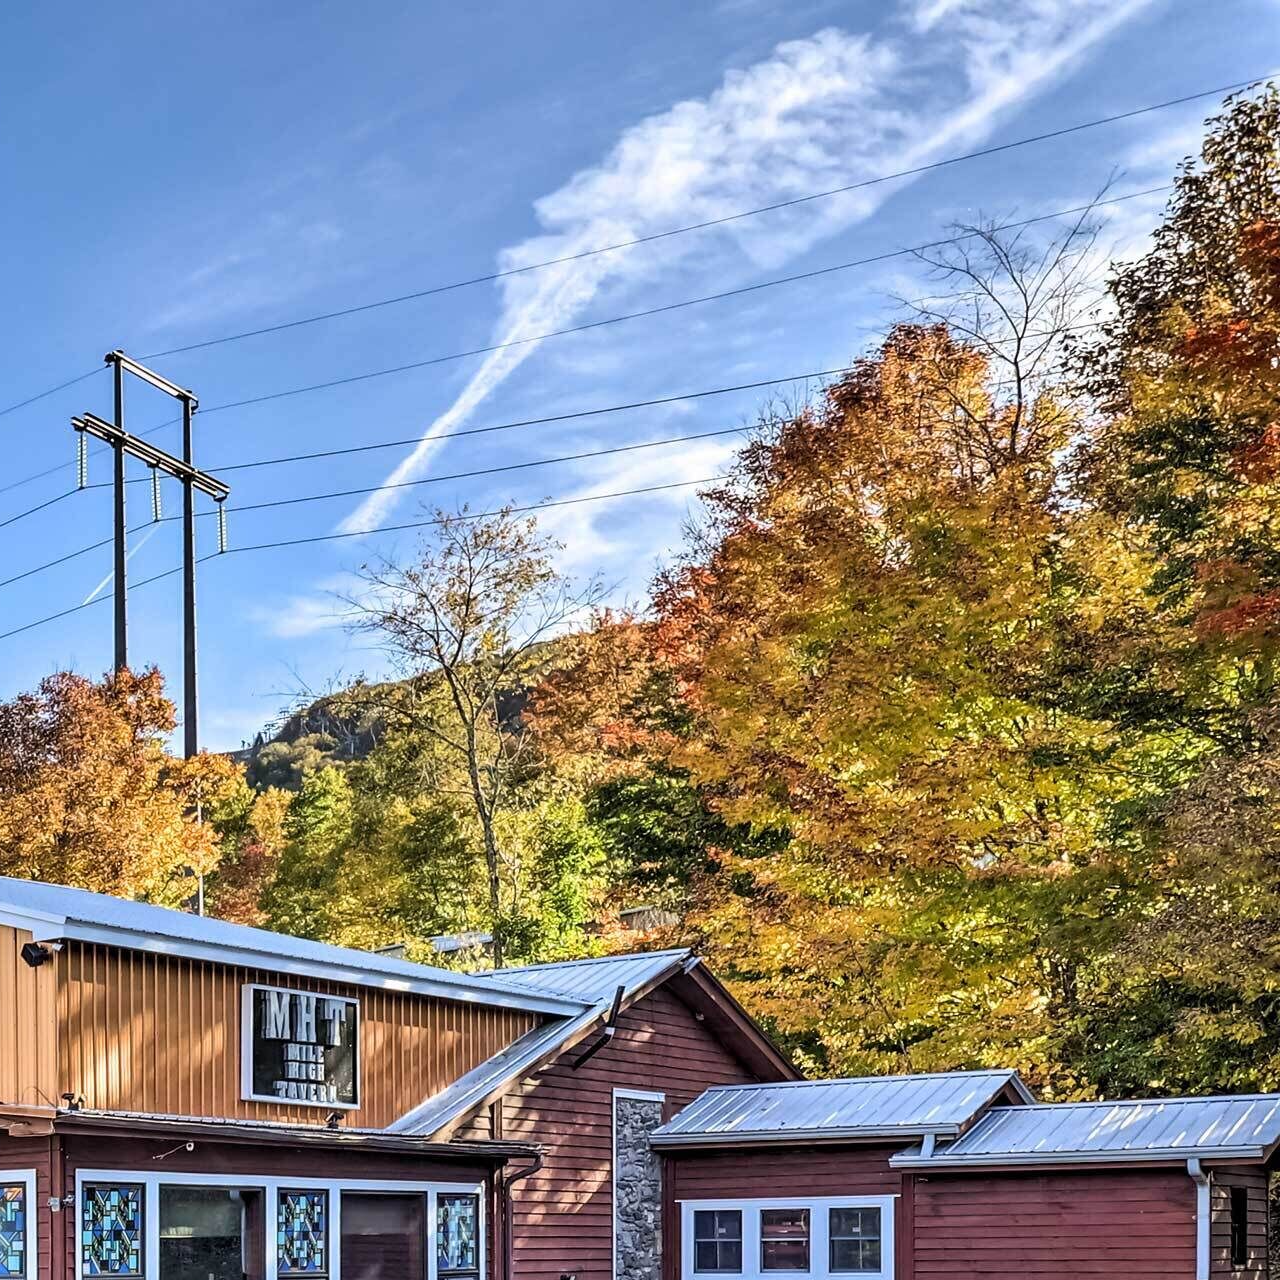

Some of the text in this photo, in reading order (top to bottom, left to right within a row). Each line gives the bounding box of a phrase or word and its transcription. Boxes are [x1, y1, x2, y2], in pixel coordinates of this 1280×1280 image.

[264, 991, 346, 1047] MHT
[285, 1043, 325, 1063] MILE
[286, 1062, 325, 1081] HIGH
[275, 1081, 337, 1102] TAVERN
